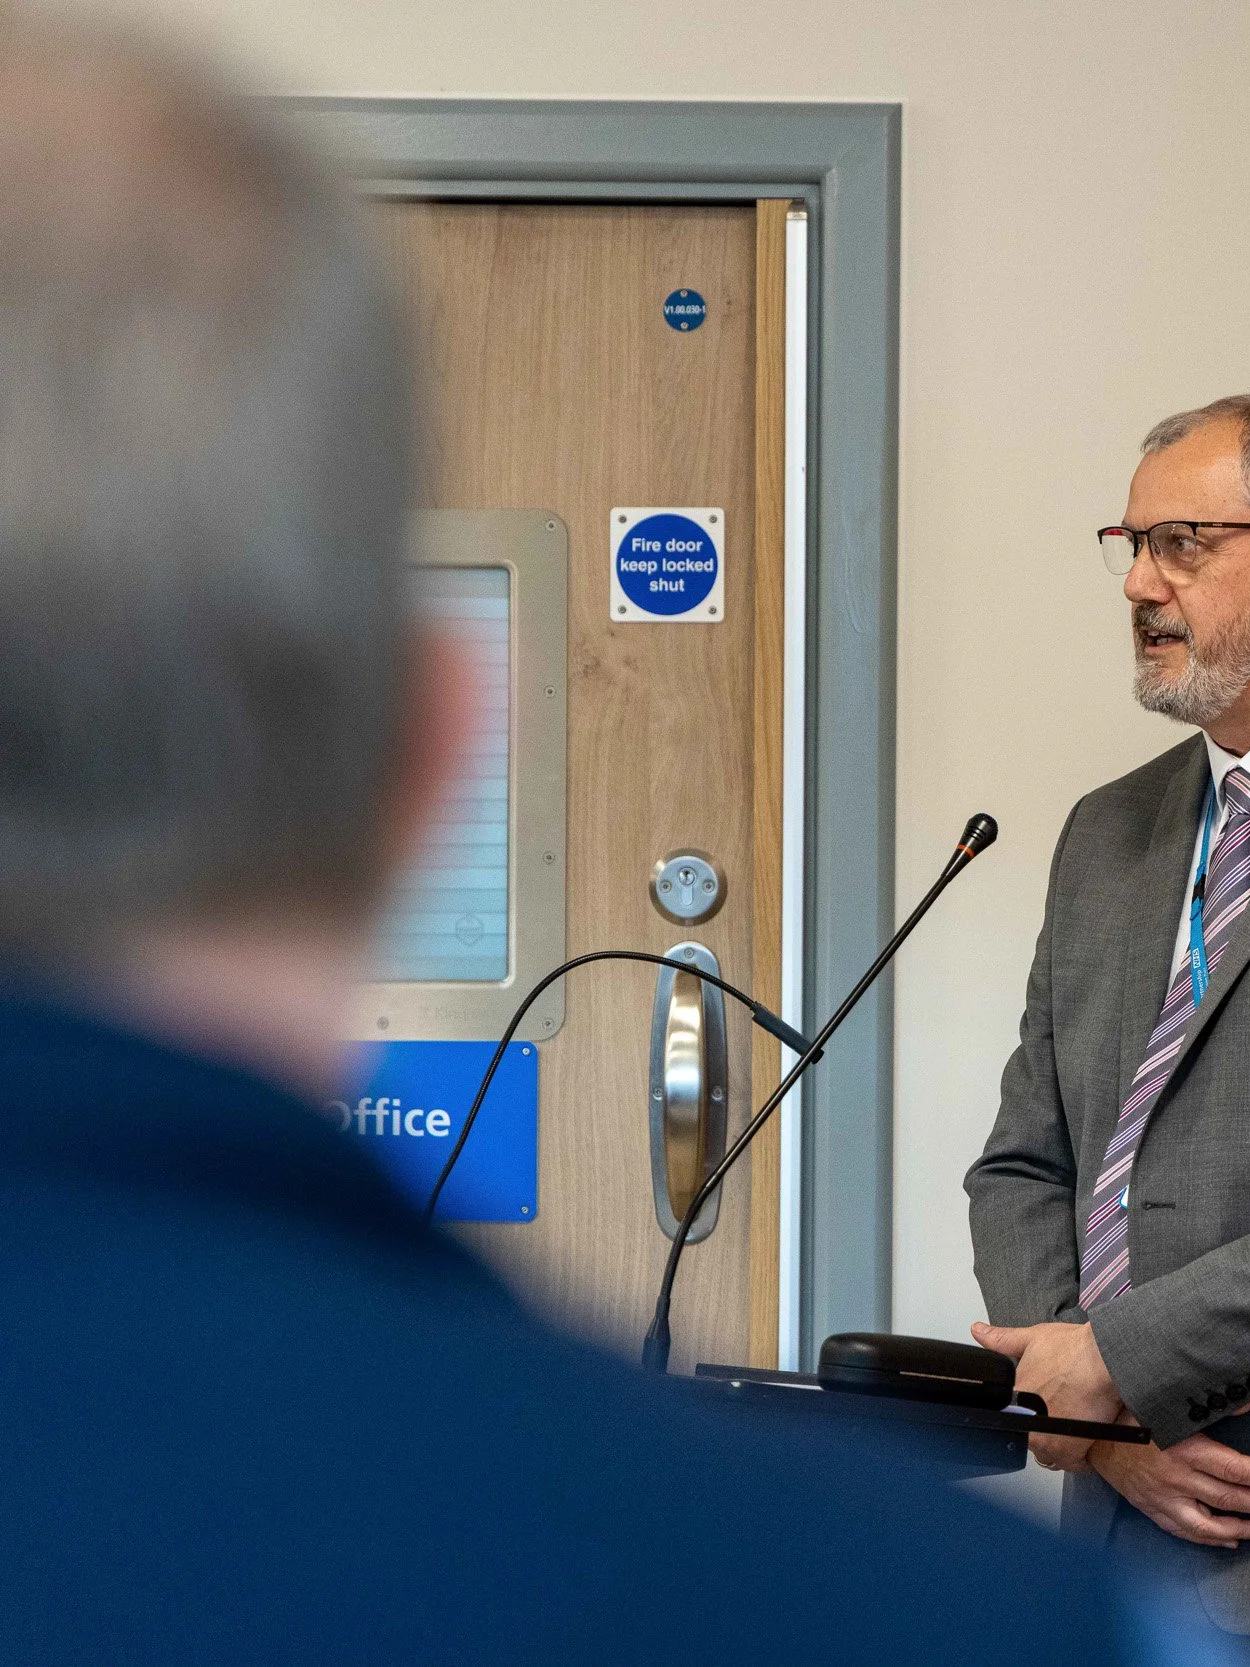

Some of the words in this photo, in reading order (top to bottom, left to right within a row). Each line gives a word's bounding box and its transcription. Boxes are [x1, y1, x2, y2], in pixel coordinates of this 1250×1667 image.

[631, 538, 662, 552] Fire
[665, 538, 703, 552] door
[620, 558, 658, 575] keep
[662, 558, 714, 572] locked
[649, 578, 685, 592] shut
